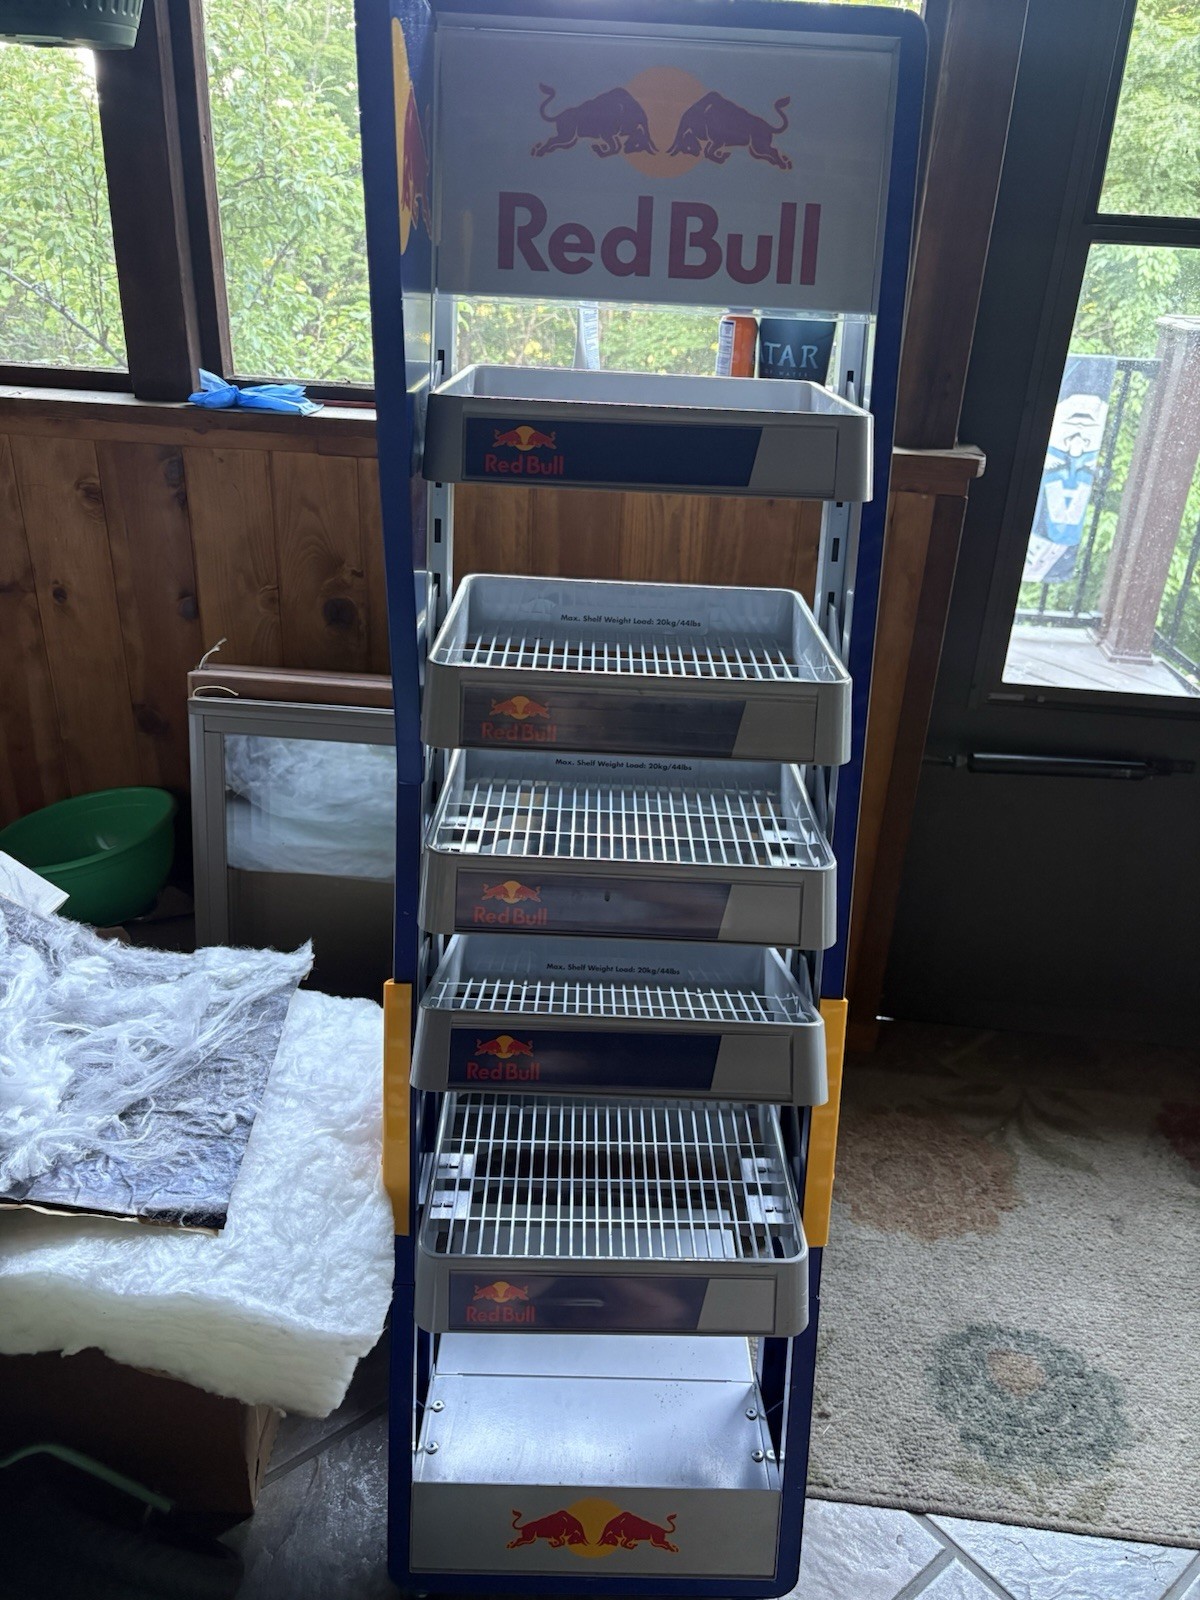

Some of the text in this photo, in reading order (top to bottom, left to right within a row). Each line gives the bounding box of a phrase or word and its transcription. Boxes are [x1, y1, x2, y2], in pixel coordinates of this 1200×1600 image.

[497, 191, 822, 287] Red Bull
[760, 341, 818, 369] TAR
[485, 453, 564, 475] Red Bull
[560, 614, 580, 622] Max.
[583, 615, 602, 623] Shelf
[604, 616, 631, 625] Weight
[657, 618, 701, 628] 20kg/44lbs
[481, 721, 558, 742] Red Bull
[555, 758, 575, 766] Max.
[577, 759, 595, 767] Shelf
[598, 760, 624, 769] Weight
[649, 763, 692, 772] 20kg/44lbs
[473, 905, 548, 926] Red Bull
[588, 965, 614, 973] Weight
[638, 967, 680, 975] 20kg/44lbs
[467, 1062, 540, 1080] Red Bull
[466, 1305, 535, 1323] Red Bull
